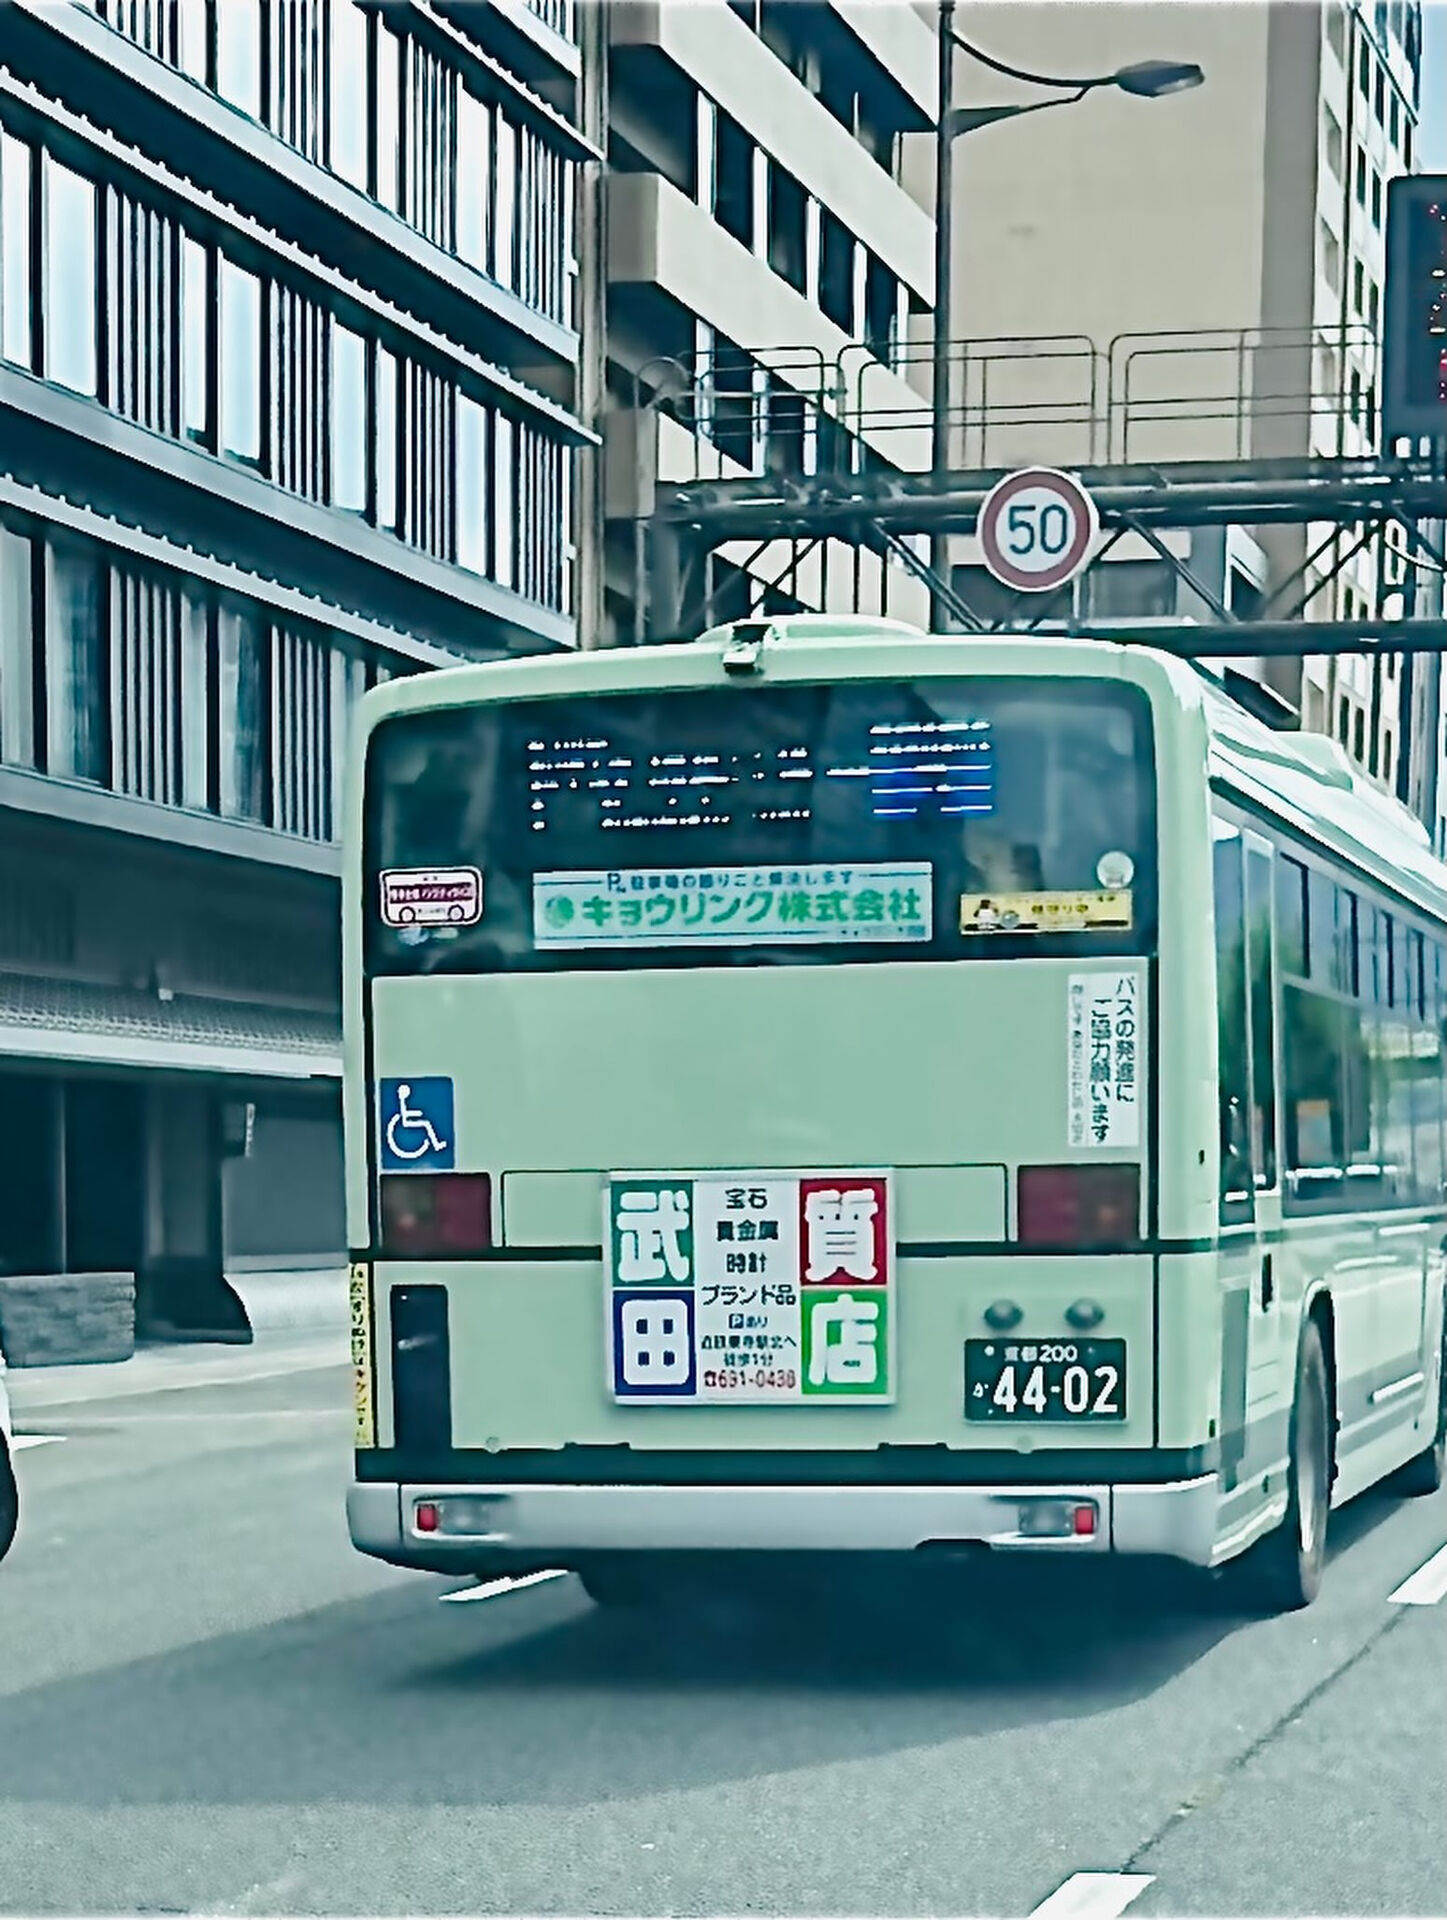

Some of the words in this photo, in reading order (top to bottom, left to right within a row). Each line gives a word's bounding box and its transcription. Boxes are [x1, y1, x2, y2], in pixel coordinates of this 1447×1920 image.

[1008, 504, 1068, 555] 50
[582, 888, 921, 928] キョウリング株式会社
[1115, 976, 1136, 1103] バスの発進に
[1090, 998, 1112, 1144] ご協力願います
[724, 1188, 769, 1210] 宝石
[716, 1219, 780, 1242] 貴金属
[725, 1253, 768, 1274] 時計
[702, 1284, 797, 1306] ブランド品
[993, 1365, 1119, 1414] 44-02
